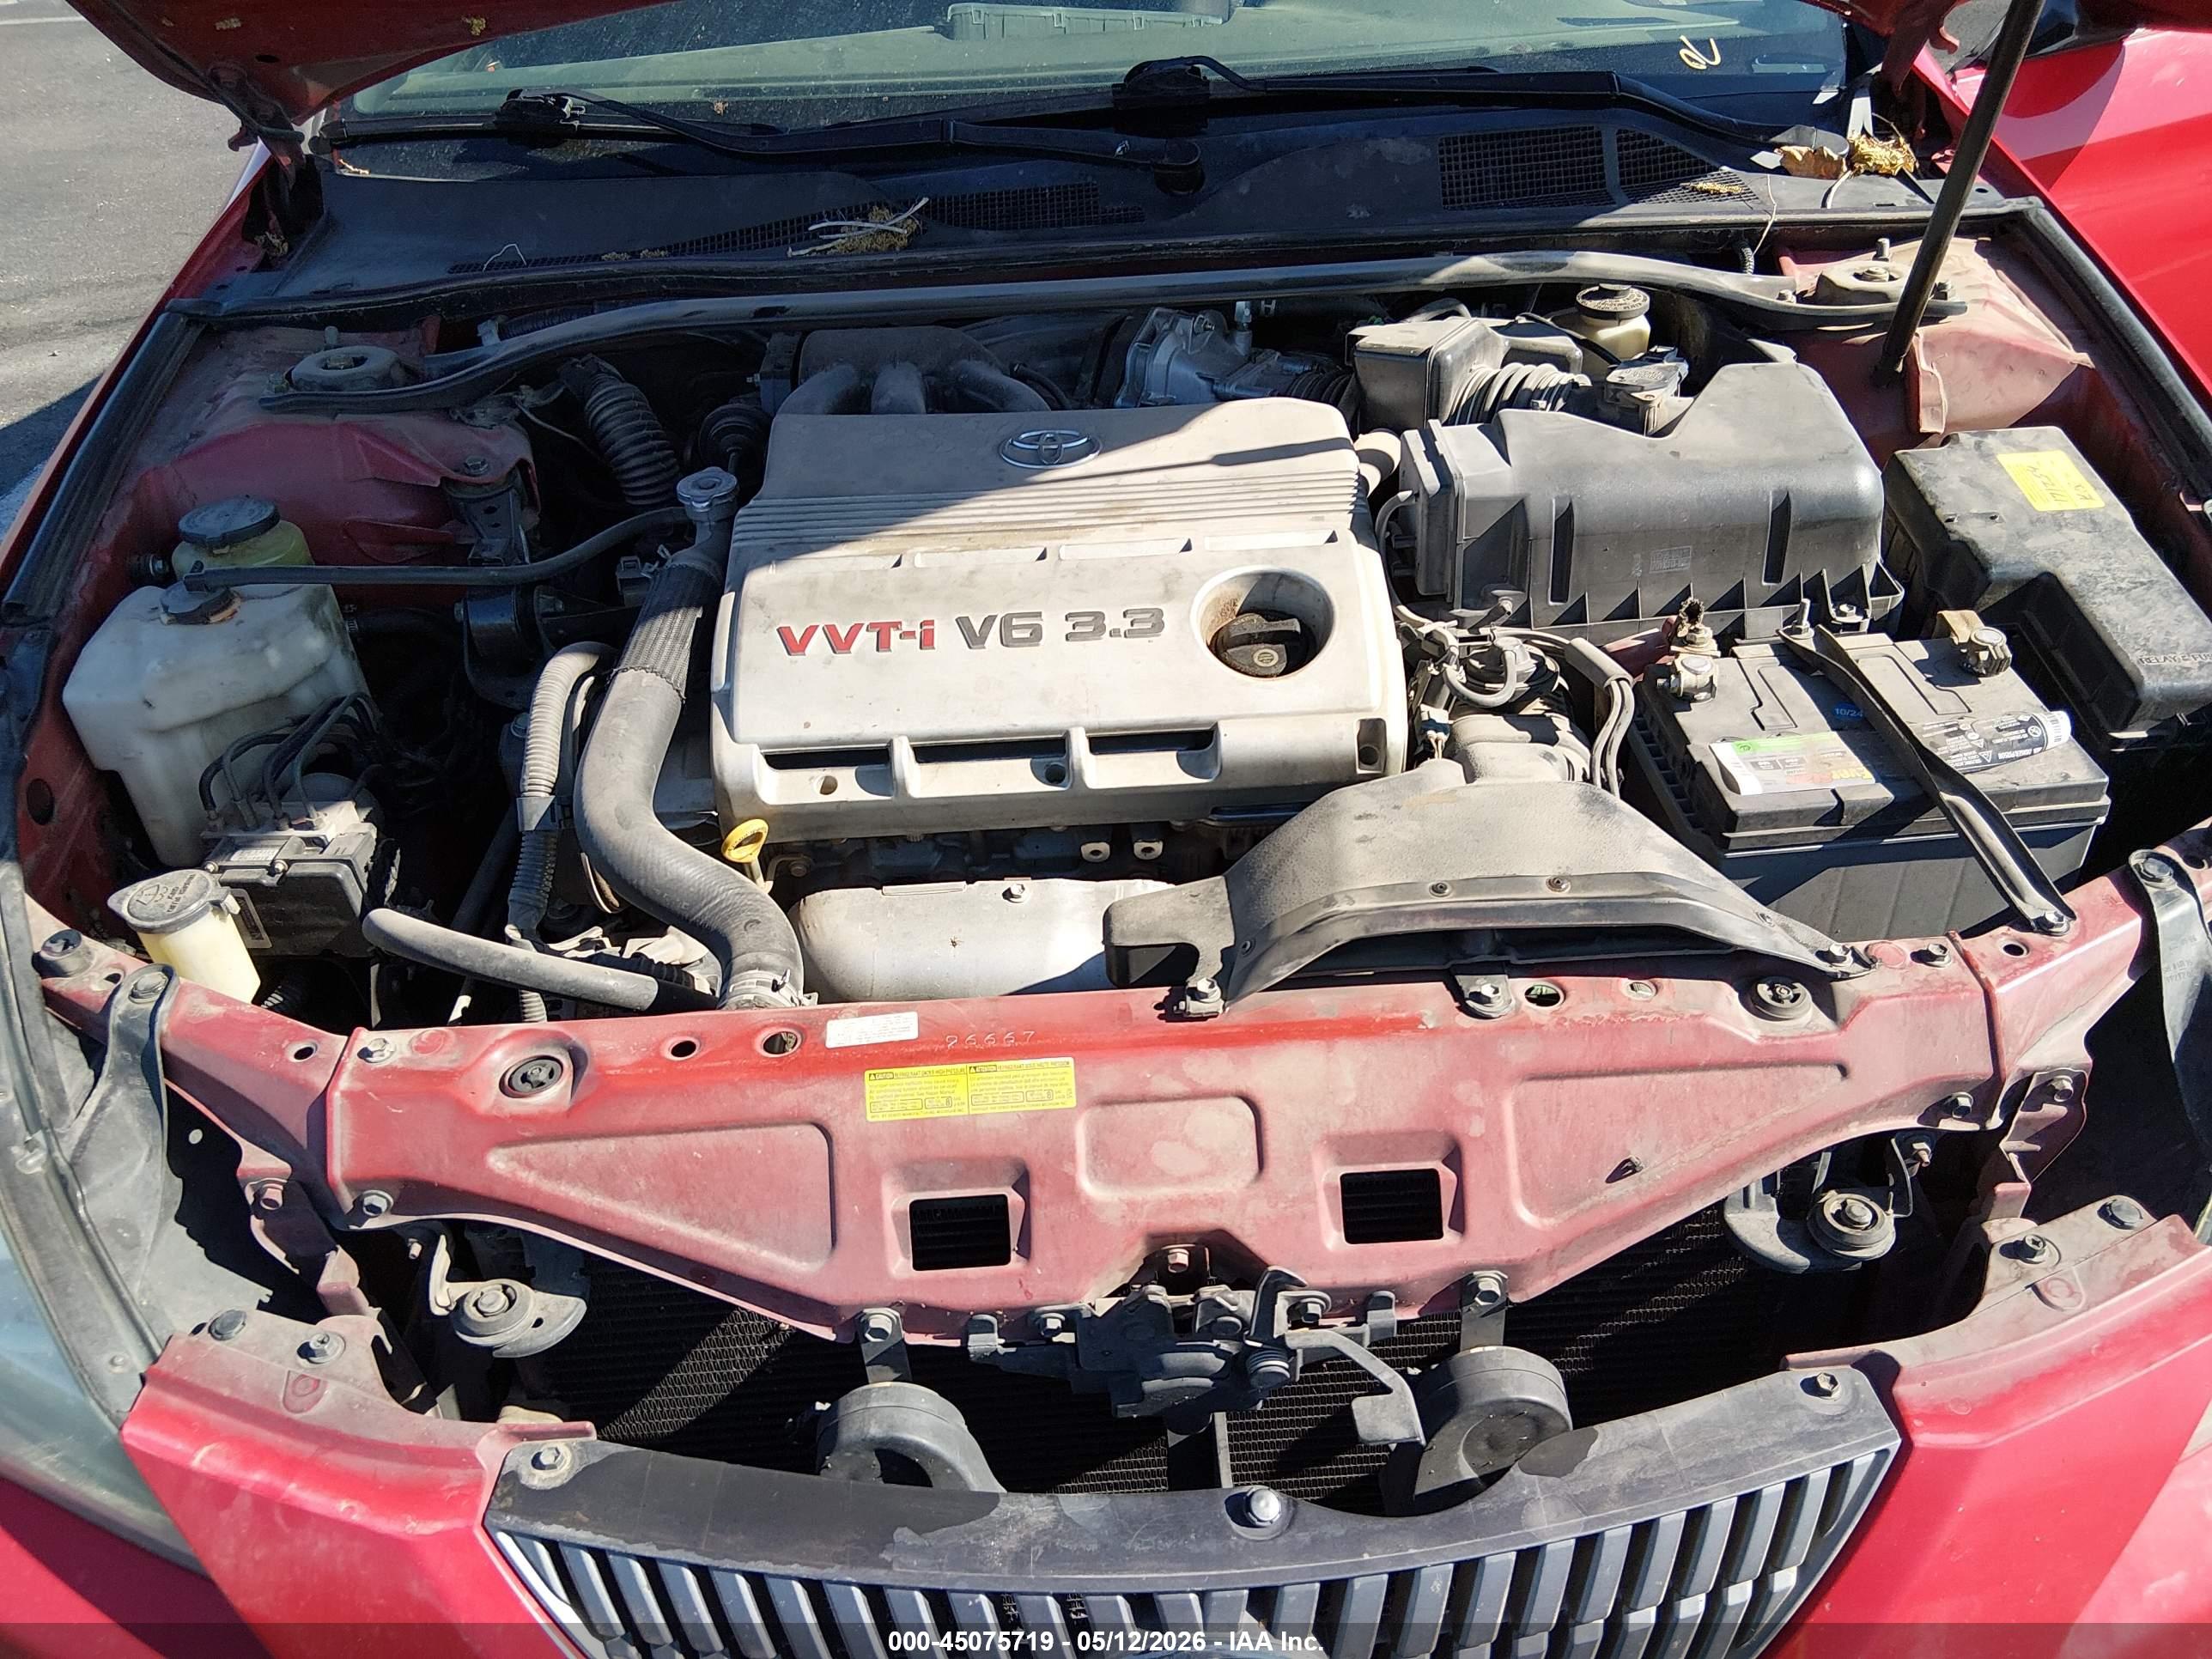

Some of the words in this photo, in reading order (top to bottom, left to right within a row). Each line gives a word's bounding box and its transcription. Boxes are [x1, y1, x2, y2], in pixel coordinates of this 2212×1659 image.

[776, 618, 935, 657] VVT-i
[955, 611, 1043, 650] V6
[1065, 606, 1166, 642] 3.3
[2138, 654, 2179, 665] RELAY
[1834, 708, 1864, 718] 10/24
